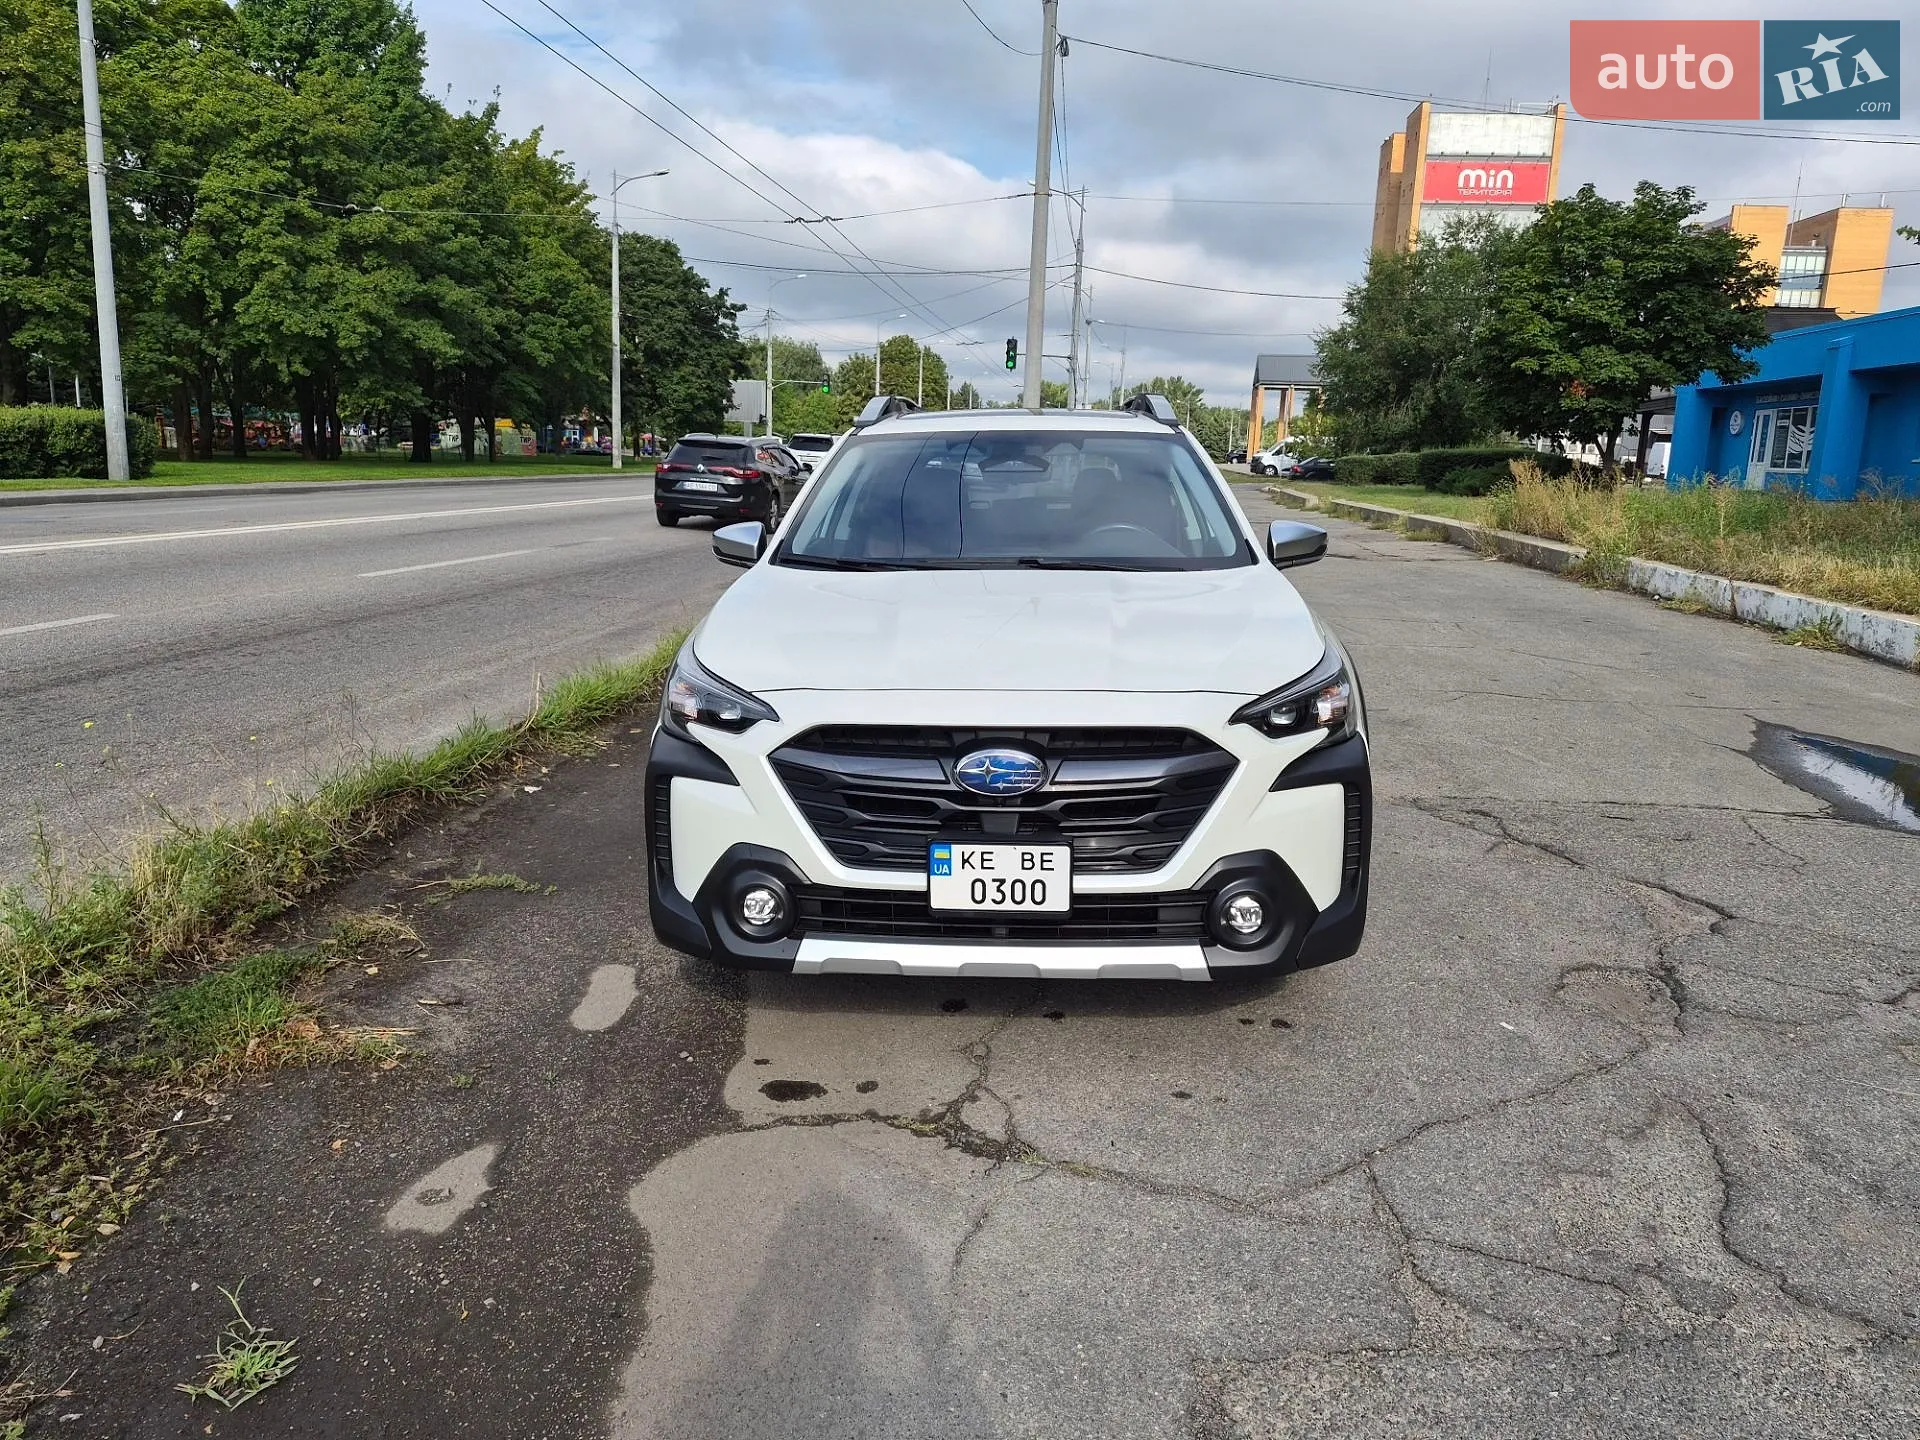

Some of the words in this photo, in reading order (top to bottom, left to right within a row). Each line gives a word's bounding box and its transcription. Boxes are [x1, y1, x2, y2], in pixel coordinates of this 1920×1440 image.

[1457, 168, 1514, 188] min
[934, 864, 950, 875] UA
[961, 851, 995, 870] KE
[1021, 852, 1055, 871] BE
[971, 877, 1047, 906] 0300
